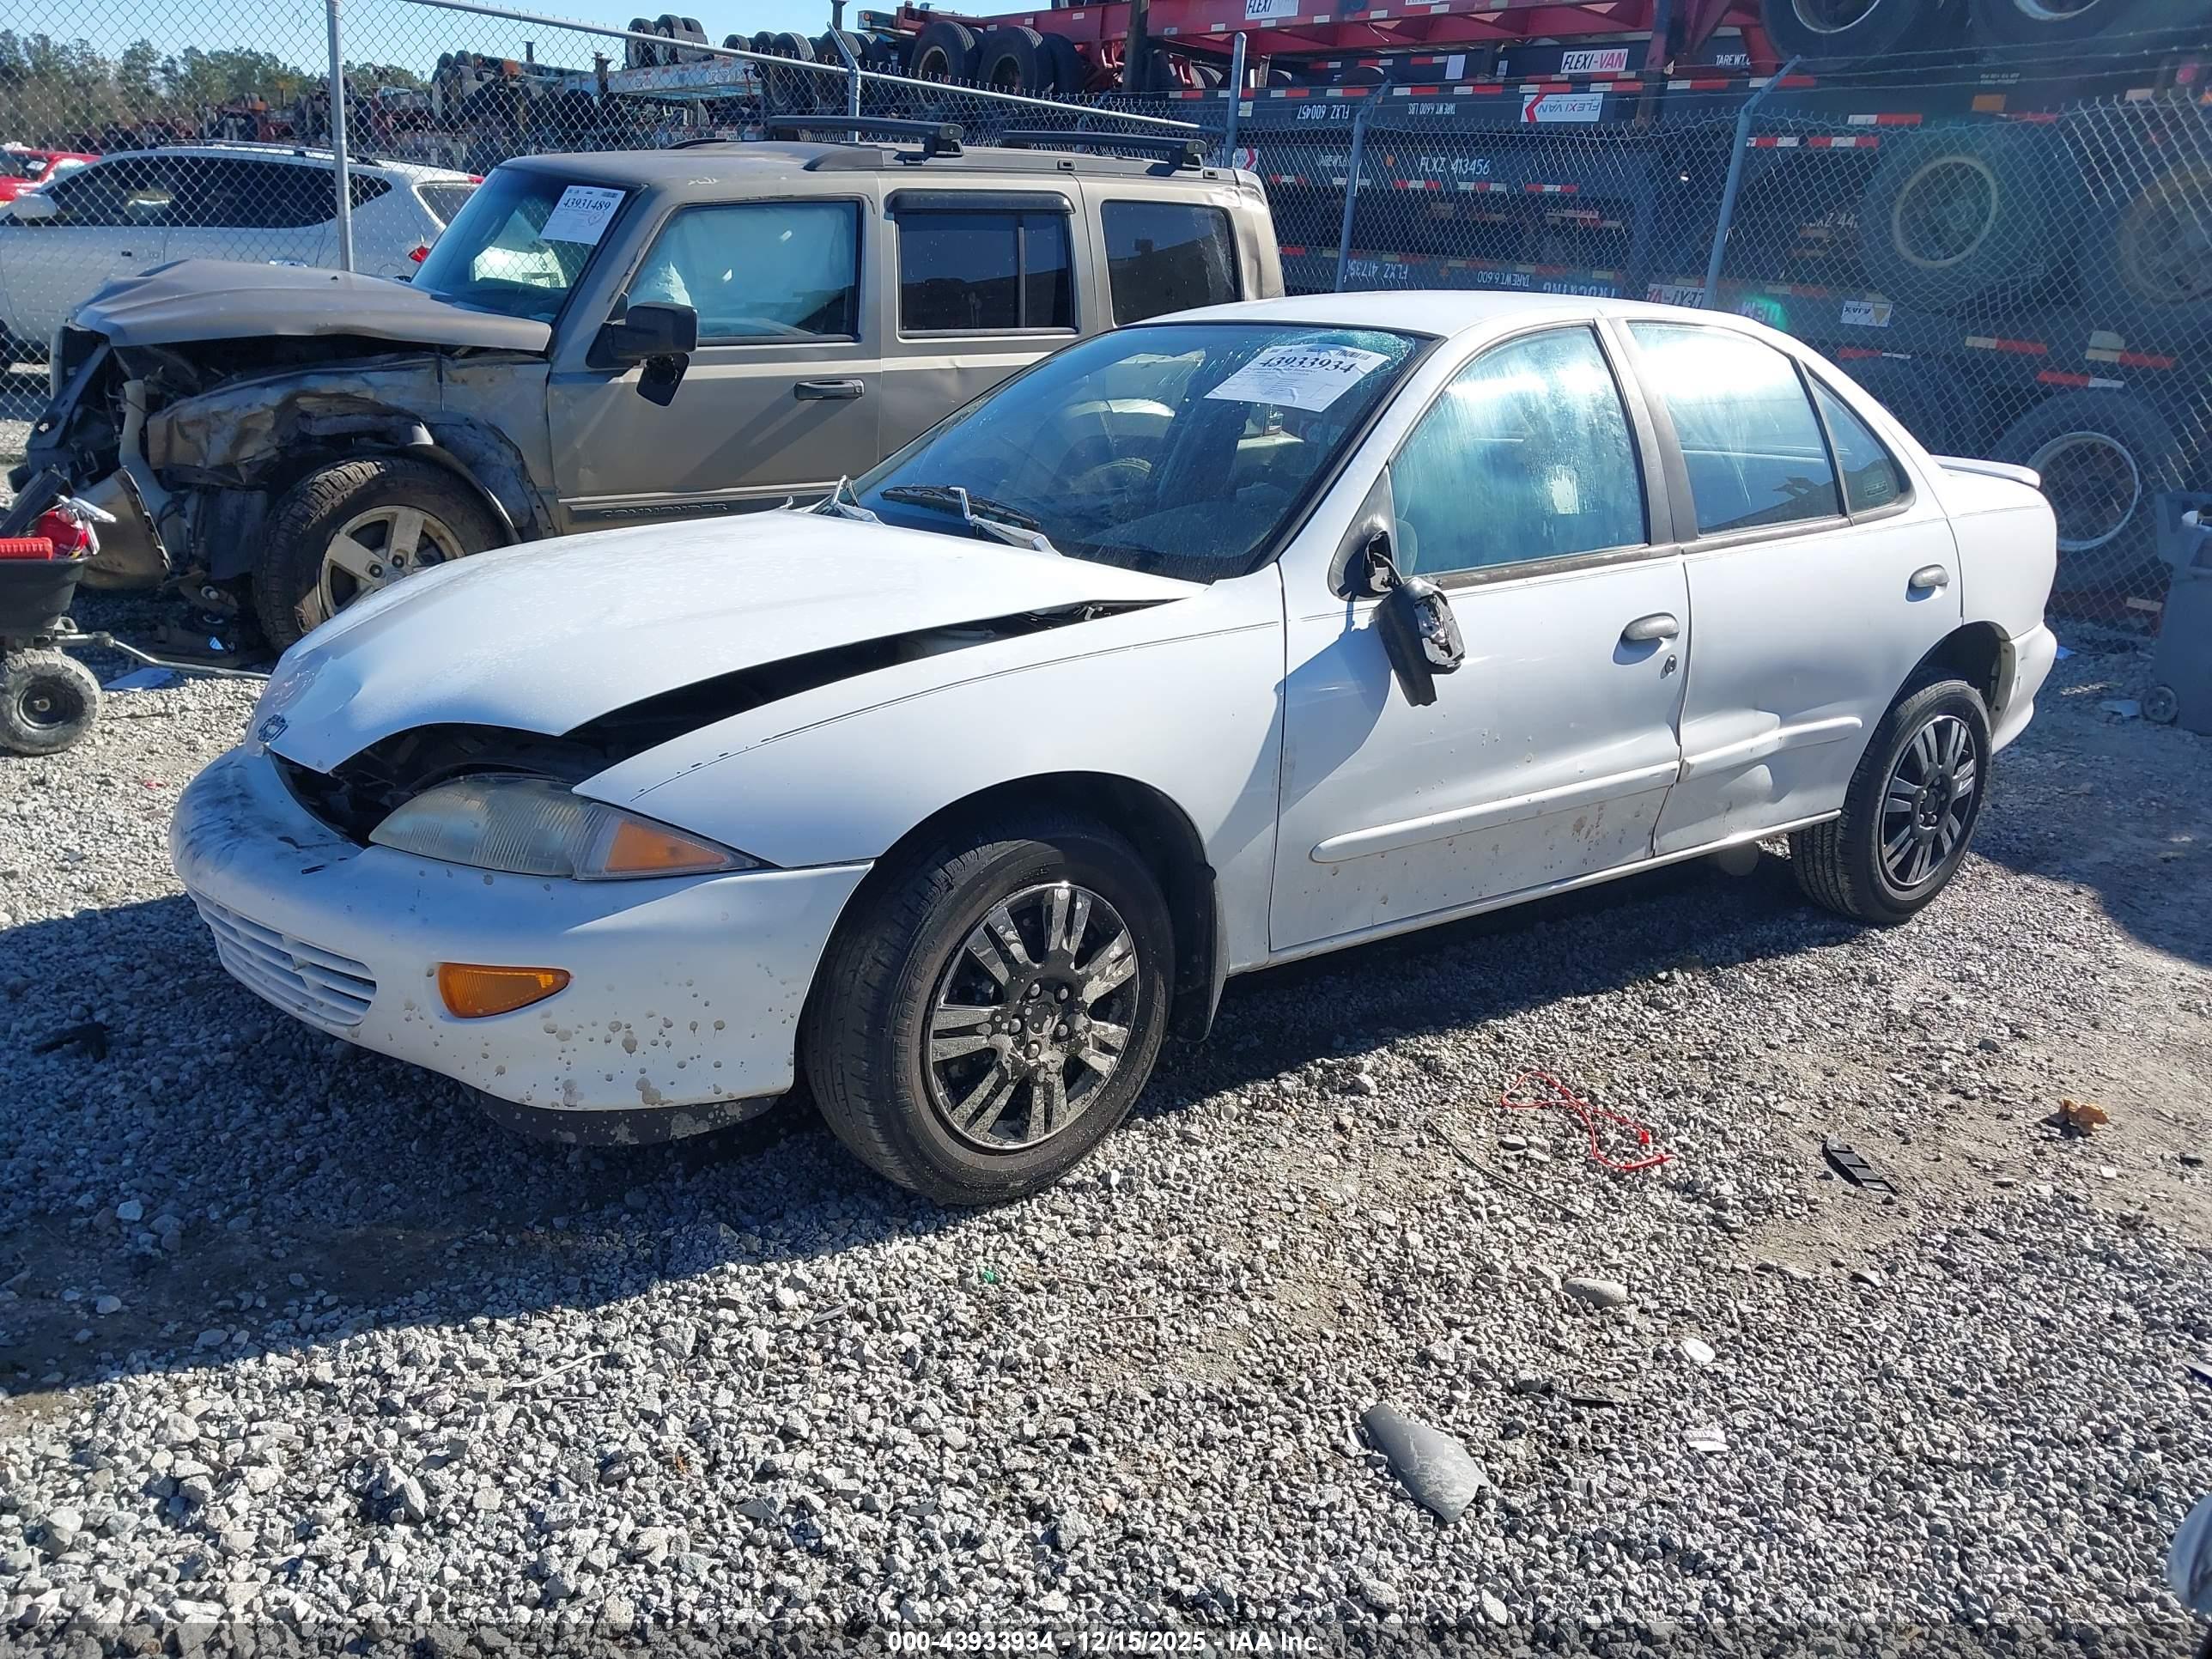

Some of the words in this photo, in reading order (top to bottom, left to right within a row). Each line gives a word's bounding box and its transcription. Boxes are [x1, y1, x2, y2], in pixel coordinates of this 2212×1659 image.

[1561, 52, 1627, 70] FLEXI-VAN
[1297, 105, 1327, 120] 600457
[1330, 104, 1351, 119] FLXZ
[1419, 156, 1447, 173] FLXZ
[1451, 158, 1491, 176] 413456
[562, 198, 611, 210] 43931489
[1383, 263, 1408, 280] FLXZ
[1259, 356, 1357, 374] 43933934
